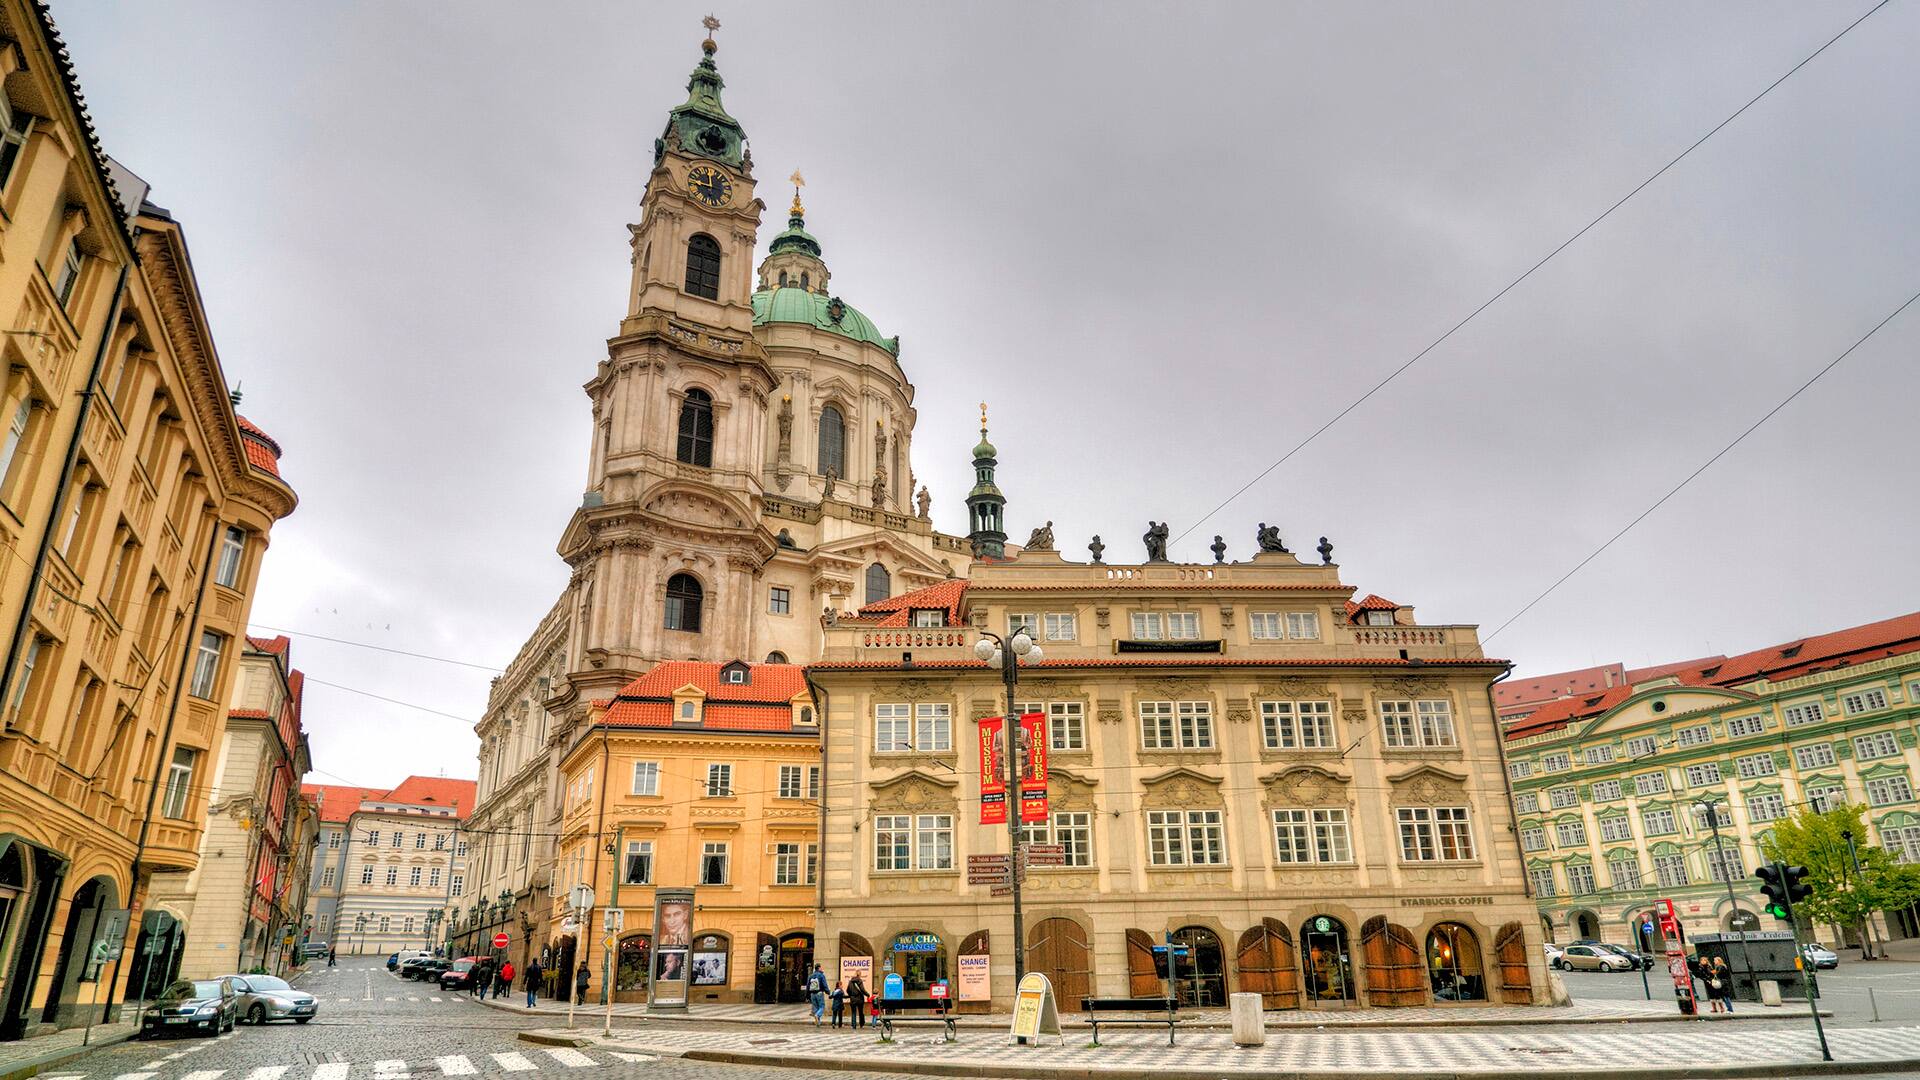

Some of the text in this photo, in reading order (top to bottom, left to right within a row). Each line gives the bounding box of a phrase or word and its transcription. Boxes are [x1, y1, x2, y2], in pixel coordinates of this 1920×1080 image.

[981, 727, 993, 785] MUSEUM
[1032, 721, 1045, 781] TORTURE
[1401, 896, 1494, 907] STARBUCKS COFFEE
[894, 943, 936, 951] CHANGE
[843, 959, 870, 968] CHANGE
[960, 957, 988, 966] CHANGE
